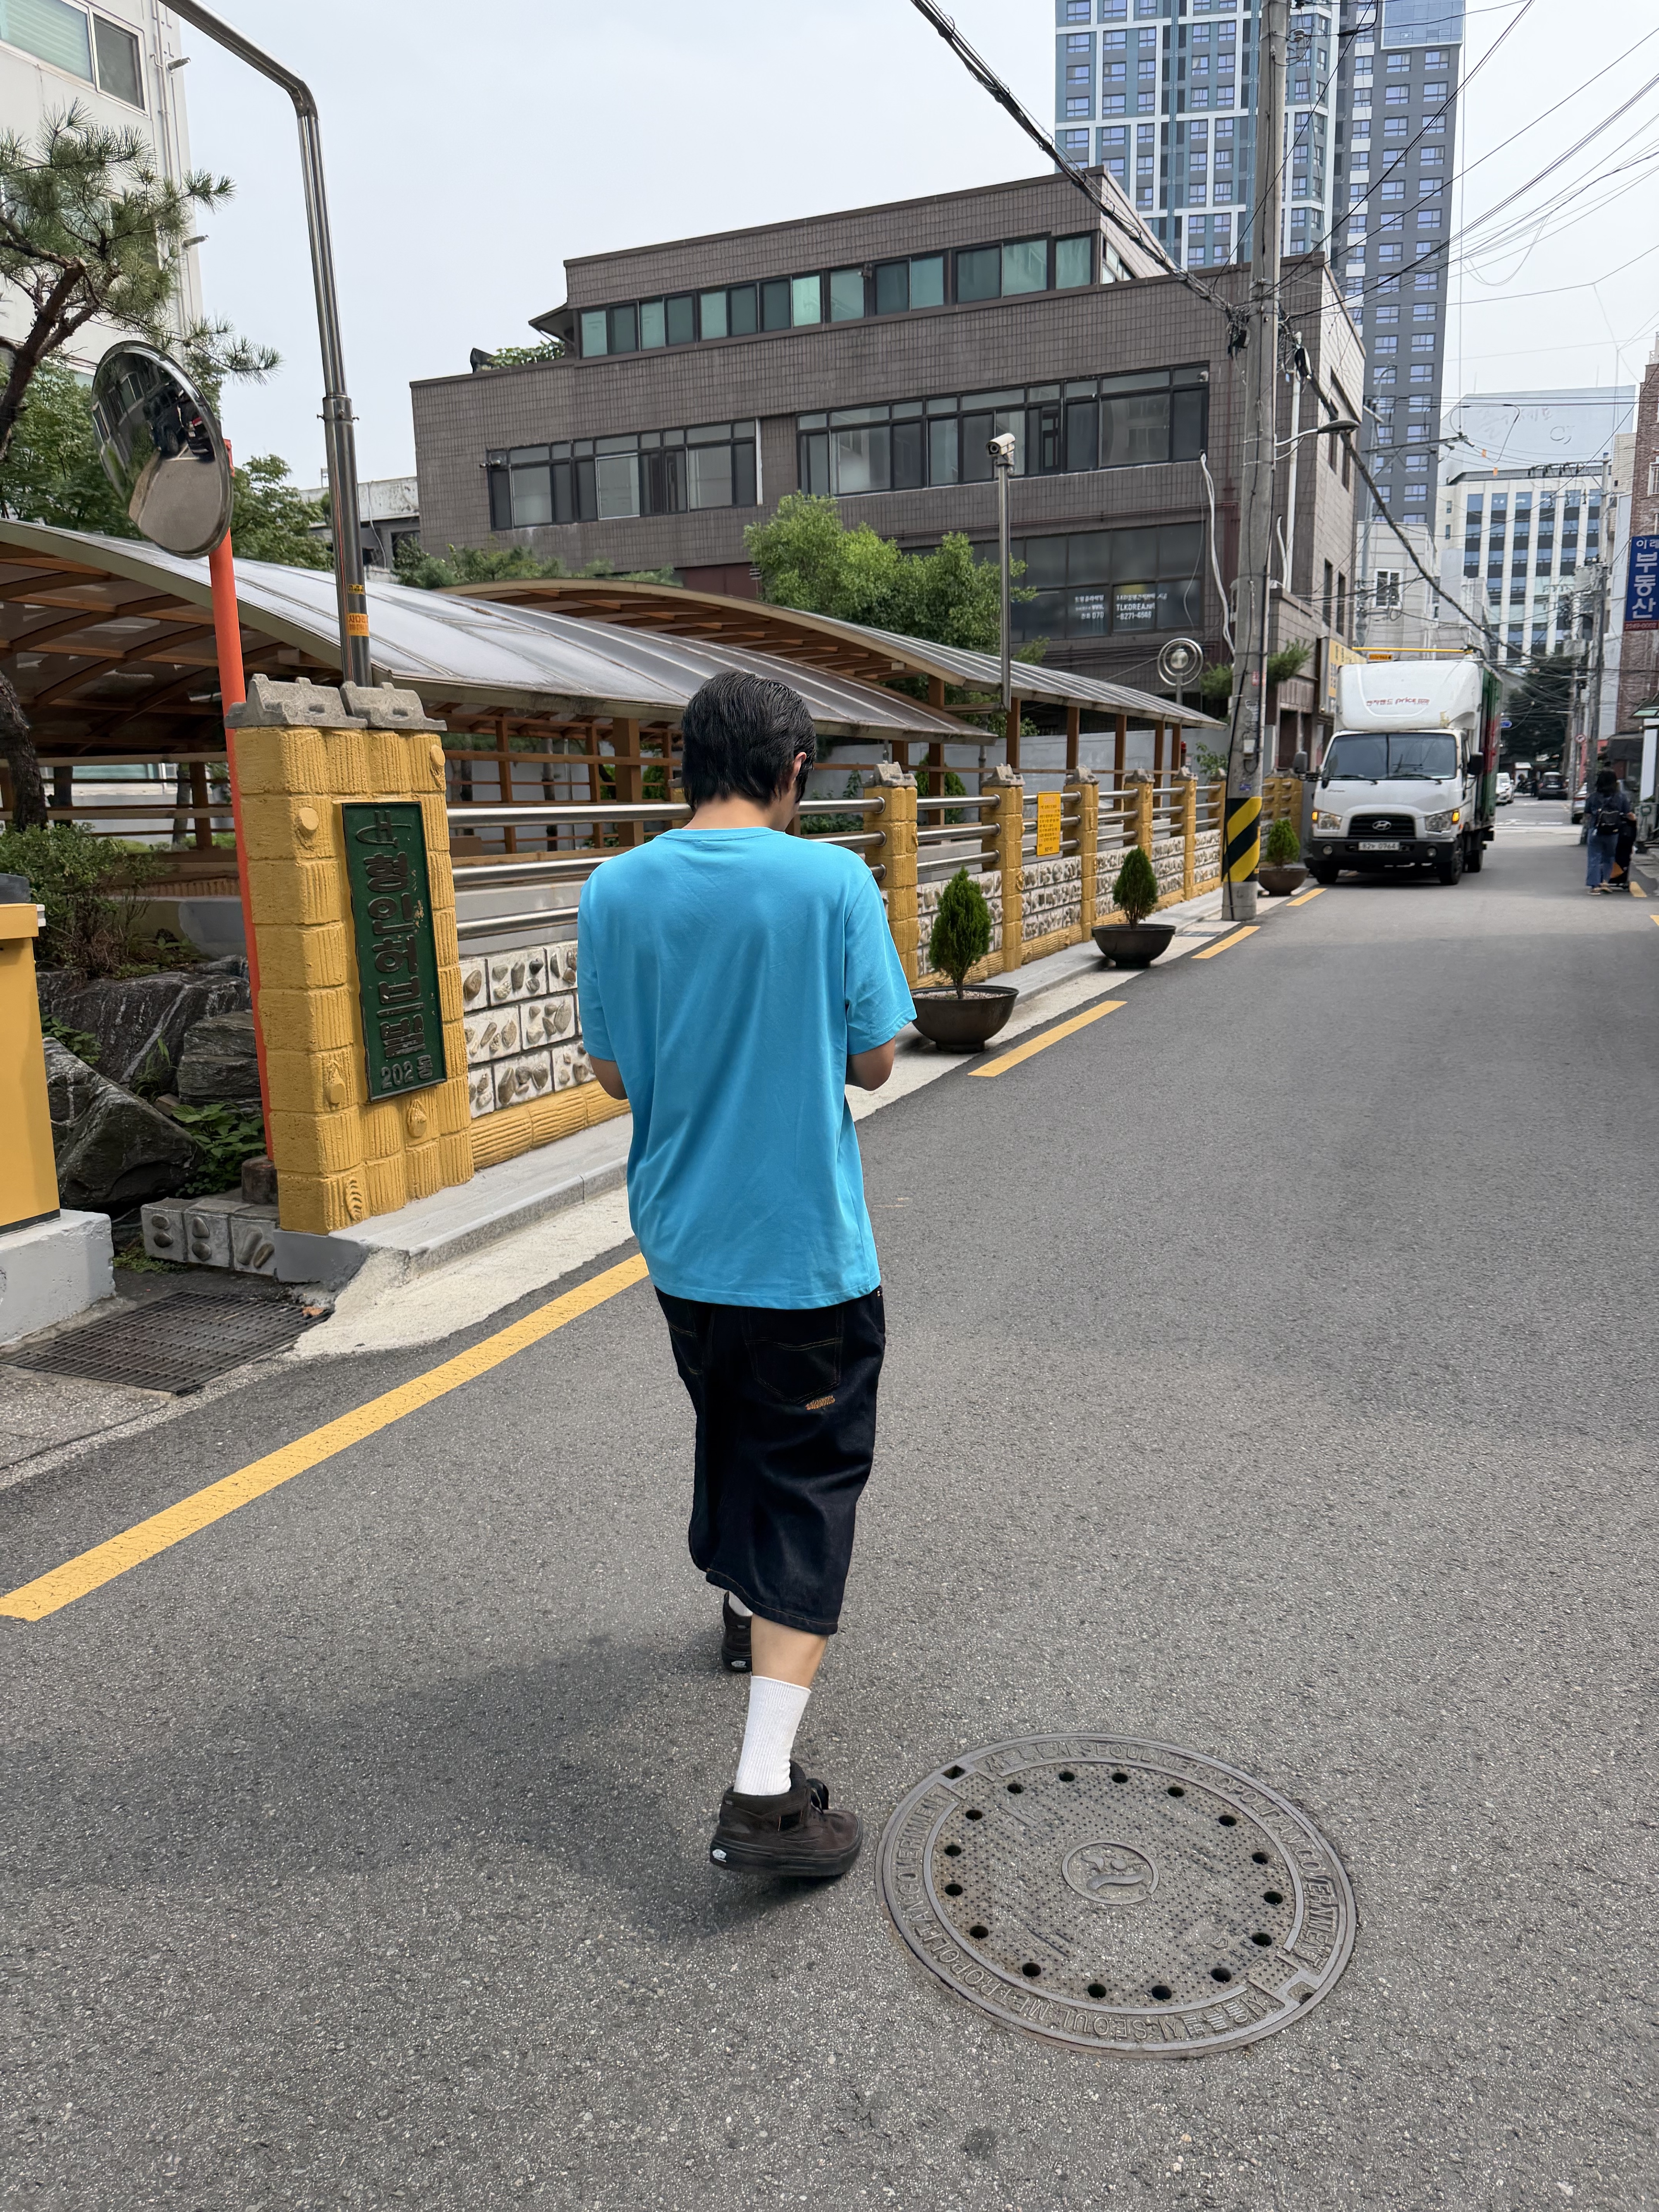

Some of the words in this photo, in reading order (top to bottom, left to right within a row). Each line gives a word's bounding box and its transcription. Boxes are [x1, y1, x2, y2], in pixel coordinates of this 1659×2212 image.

[1632, 551, 1658, 619] 부동산
[364, 851, 425, 1058] 형인허브빌
[381, 1054, 433, 1089] 202동
[895, 1791, 947, 1895] GOVERNMENT
[1080, 1743, 1152, 1762] SEOUL
[1158, 1755, 1305, 1844] METROPOLITAN
[1294, 1849, 1338, 1971] GOVERNMENT
[904, 1900, 1051, 2020] METROPOLITAN
[1061, 2009, 1148, 2039] SEOUL
